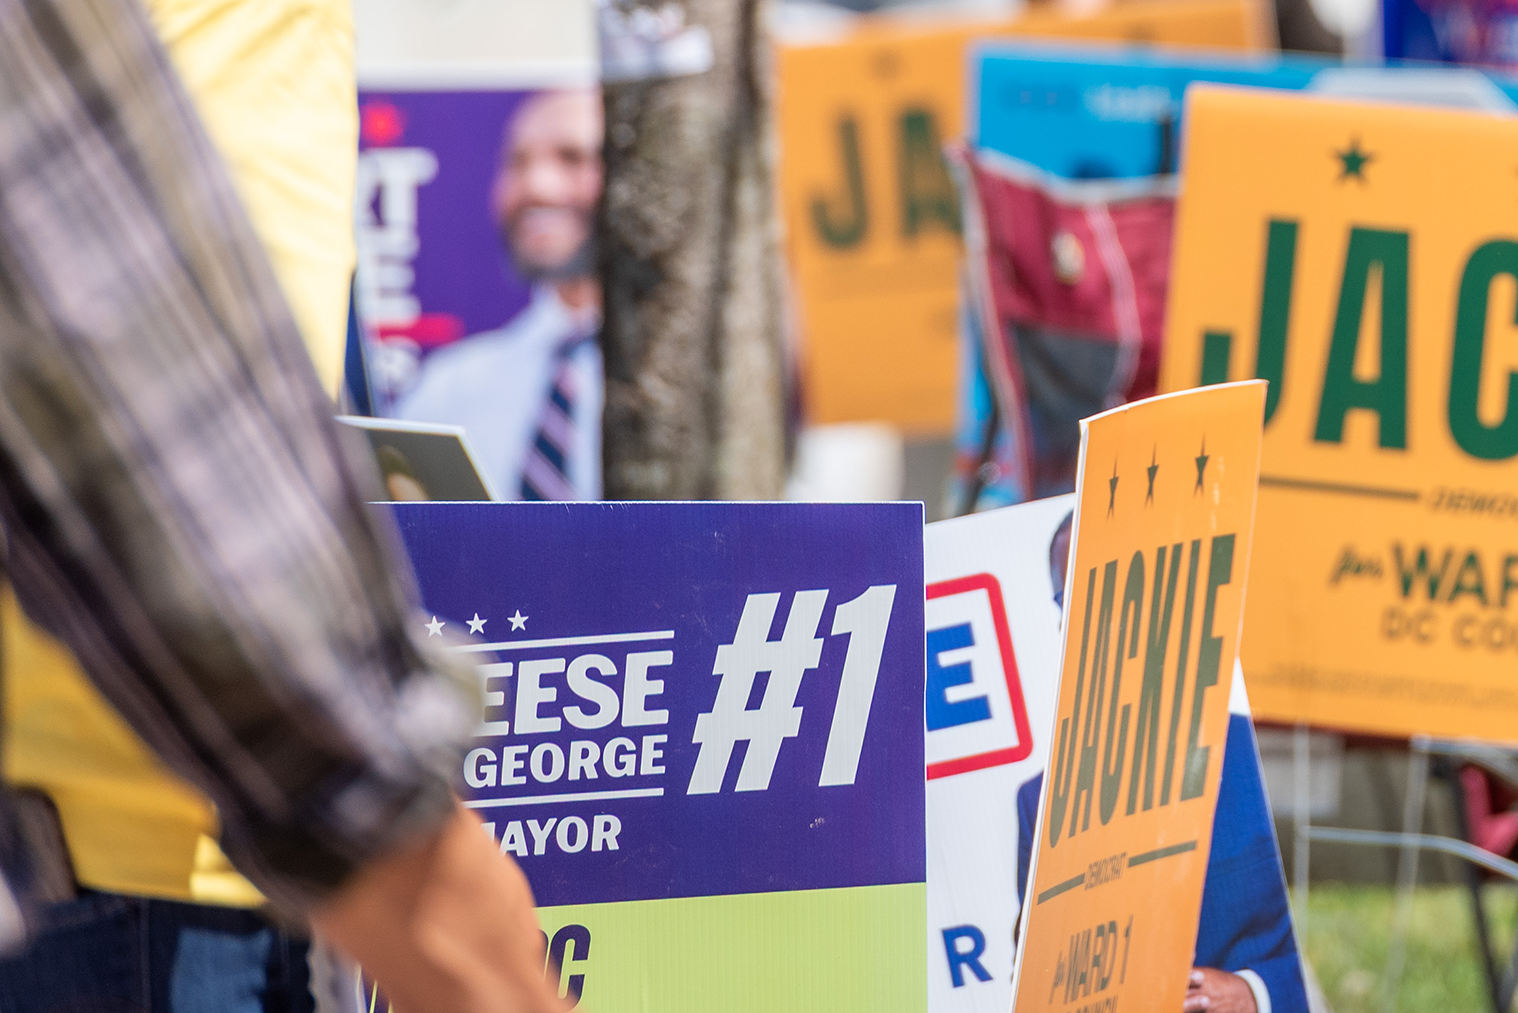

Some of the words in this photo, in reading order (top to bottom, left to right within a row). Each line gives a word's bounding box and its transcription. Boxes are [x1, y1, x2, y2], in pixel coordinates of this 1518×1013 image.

[687, 583, 898, 796] #1
[1049, 533, 1236, 849] JACKIE
[1381, 607, 1439, 644] DC
[462, 734, 668, 789] GEORGE
